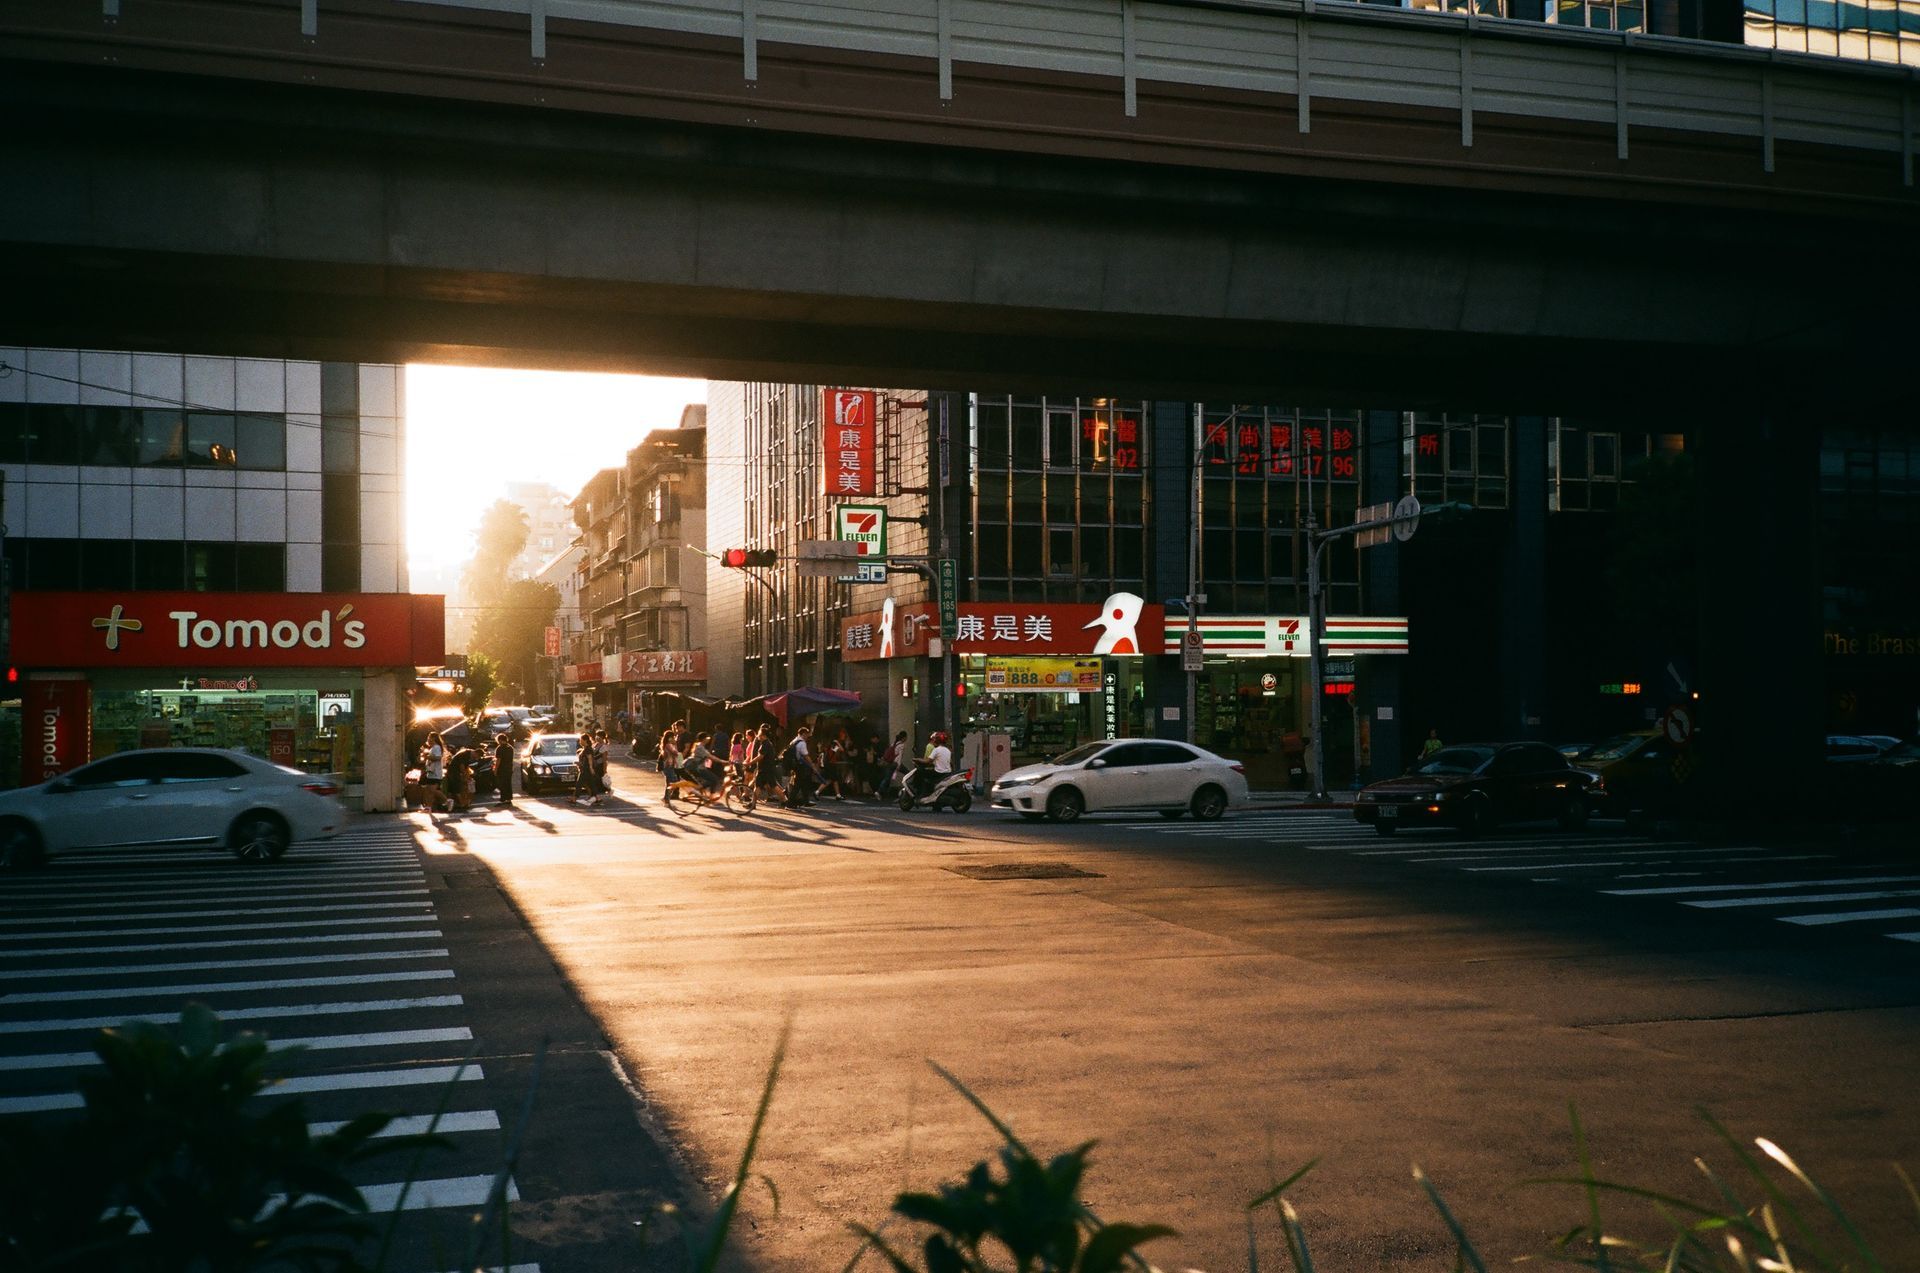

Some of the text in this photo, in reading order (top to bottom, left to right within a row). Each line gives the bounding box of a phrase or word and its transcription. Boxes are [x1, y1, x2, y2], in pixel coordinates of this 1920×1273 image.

[839, 429, 861, 492] 康是美
[1116, 447, 1138, 468] 02
[847, 513, 877, 555] 7
[169, 603, 366, 649] Tomod's
[847, 623, 873, 650] 康是美
[956, 614, 1053, 642] 康是美
[1278, 619, 1300, 651] 7
[626, 654, 694, 674] 大江南北
[198, 672, 258, 691] Tomod's
[1012, 672, 1039, 685] 888
[272, 744, 292, 756] 150
